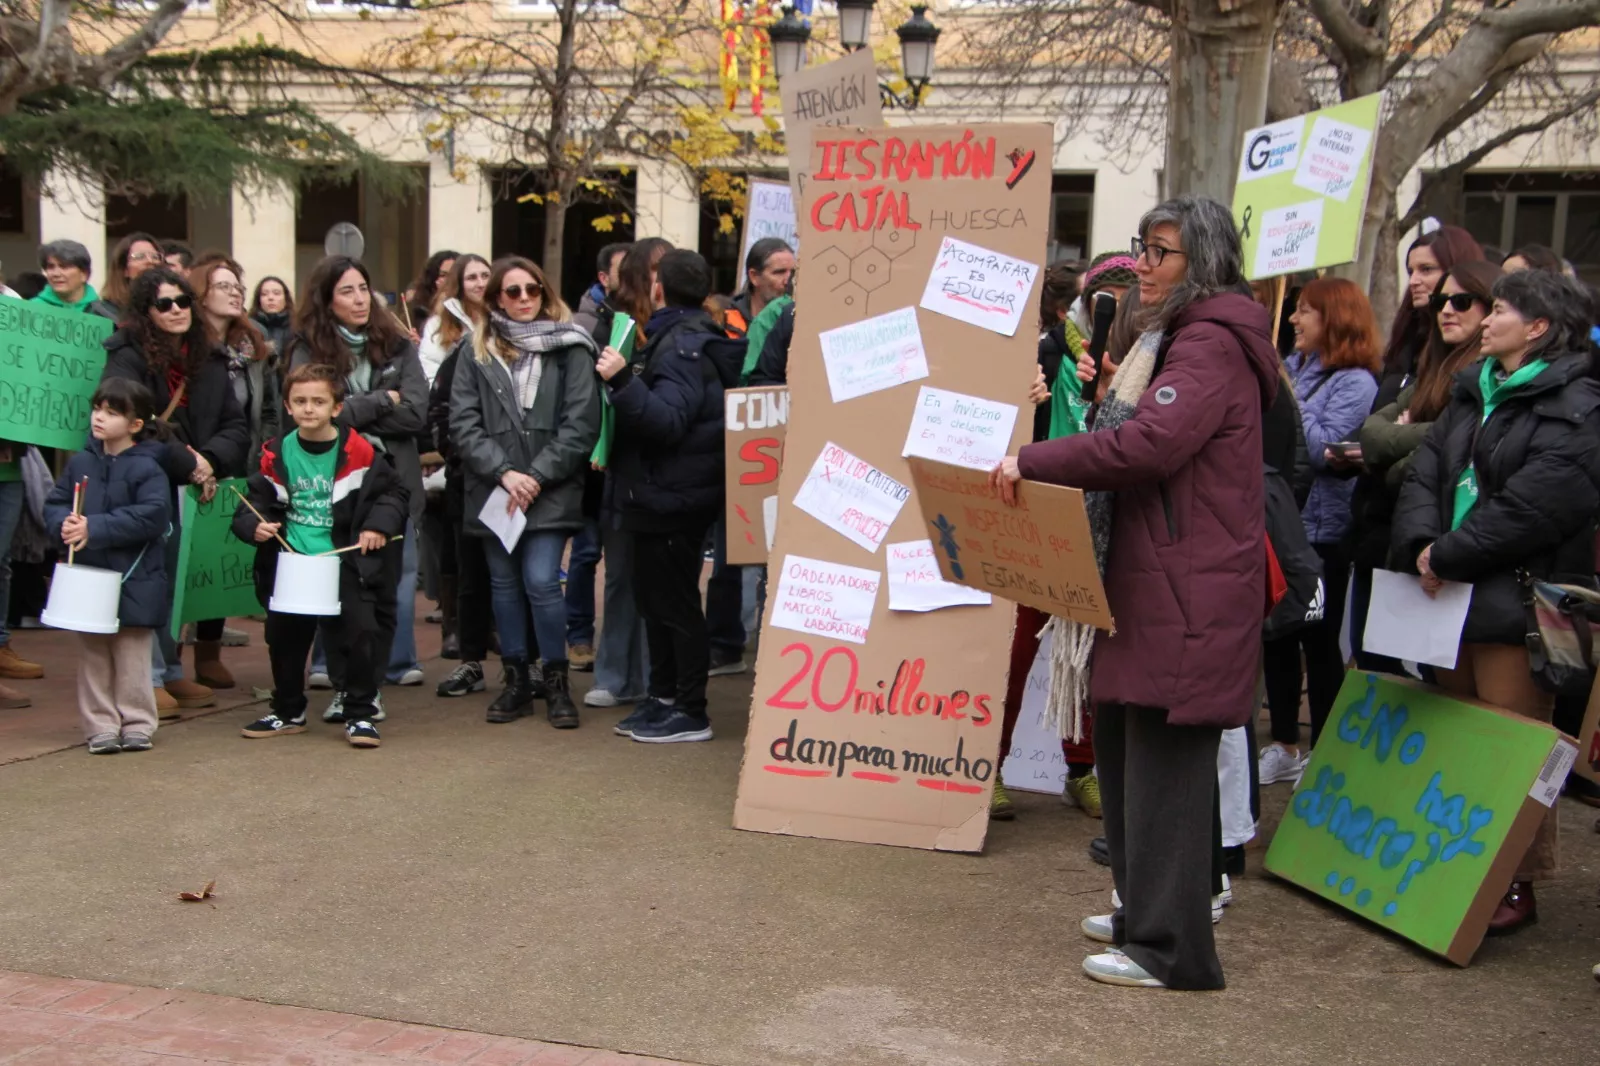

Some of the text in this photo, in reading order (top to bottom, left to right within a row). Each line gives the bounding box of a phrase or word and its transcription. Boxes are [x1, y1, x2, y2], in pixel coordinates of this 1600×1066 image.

[793, 75, 866, 120] ATENCIÓN
[813, 139, 880, 181] IES
[881, 129, 996, 182] RAMÓN
[811, 185, 1028, 232] CAJAL HUESCA
[1285, 211, 1298, 221] SIN
[943, 243, 1031, 283] ACOMPAÑAR
[1272, 248, 1283, 258] NO
[942, 276, 1016, 314] EDUCAR
[969, 270, 986, 282] ES
[0, 303, 102, 350] EDUCACIÓN
[2, 343, 96, 382] SE VENDE
[726, 391, 790, 431] CON
[924, 394, 941, 407] En
[824, 446, 845, 469] CON
[846, 457, 868, 479] LOS
[865, 469, 911, 502] CRITERIOS
[789, 563, 878, 593] ORDENADORES
[904, 564, 936, 585] MÁS
[782, 601, 842, 622] MATERIAL
[788, 585, 834, 603] LIBROS
[765, 642, 993, 727] 20 millones
[901, 737, 993, 783] mucho
[1030, 750, 1045, 762] 20
[1033, 770, 1048, 780] LA
